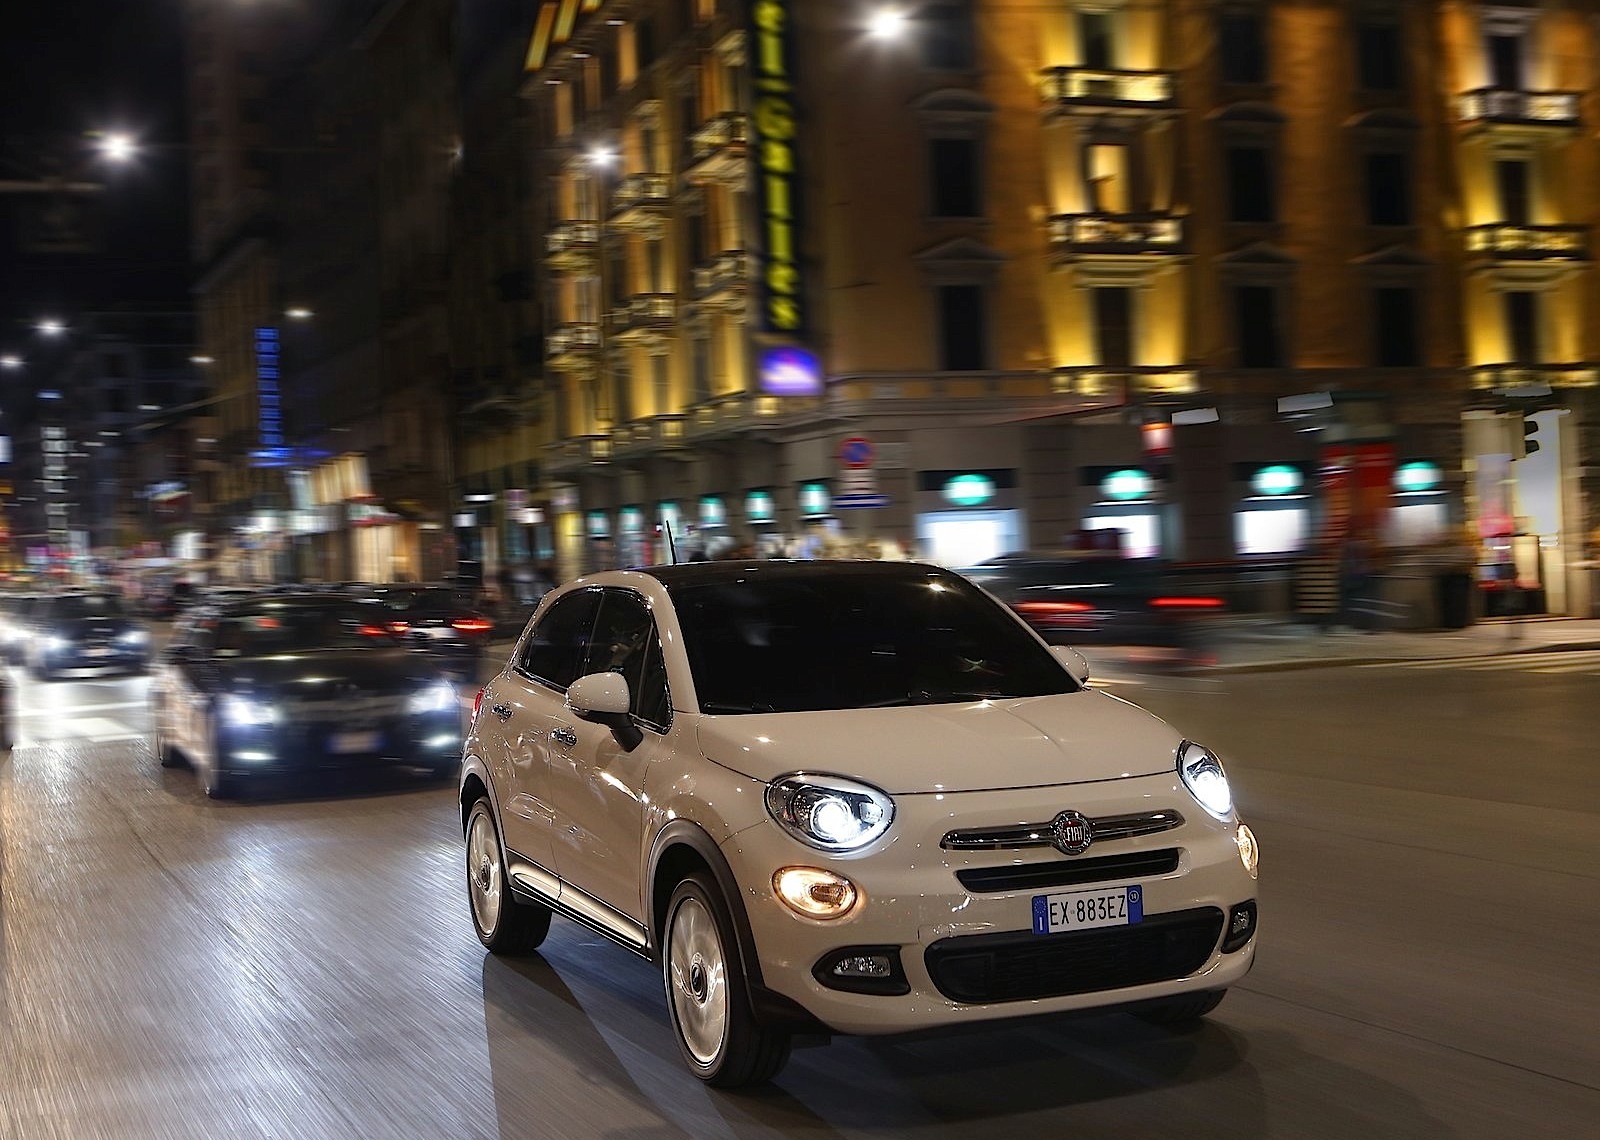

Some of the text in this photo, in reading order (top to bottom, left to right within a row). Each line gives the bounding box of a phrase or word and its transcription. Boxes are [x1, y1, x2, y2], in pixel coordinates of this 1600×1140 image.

[1066, 826, 1083, 842] FIAT
[1049, 895, 1127, 925] EX 883EZ
[1039, 916, 1044, 931] I
